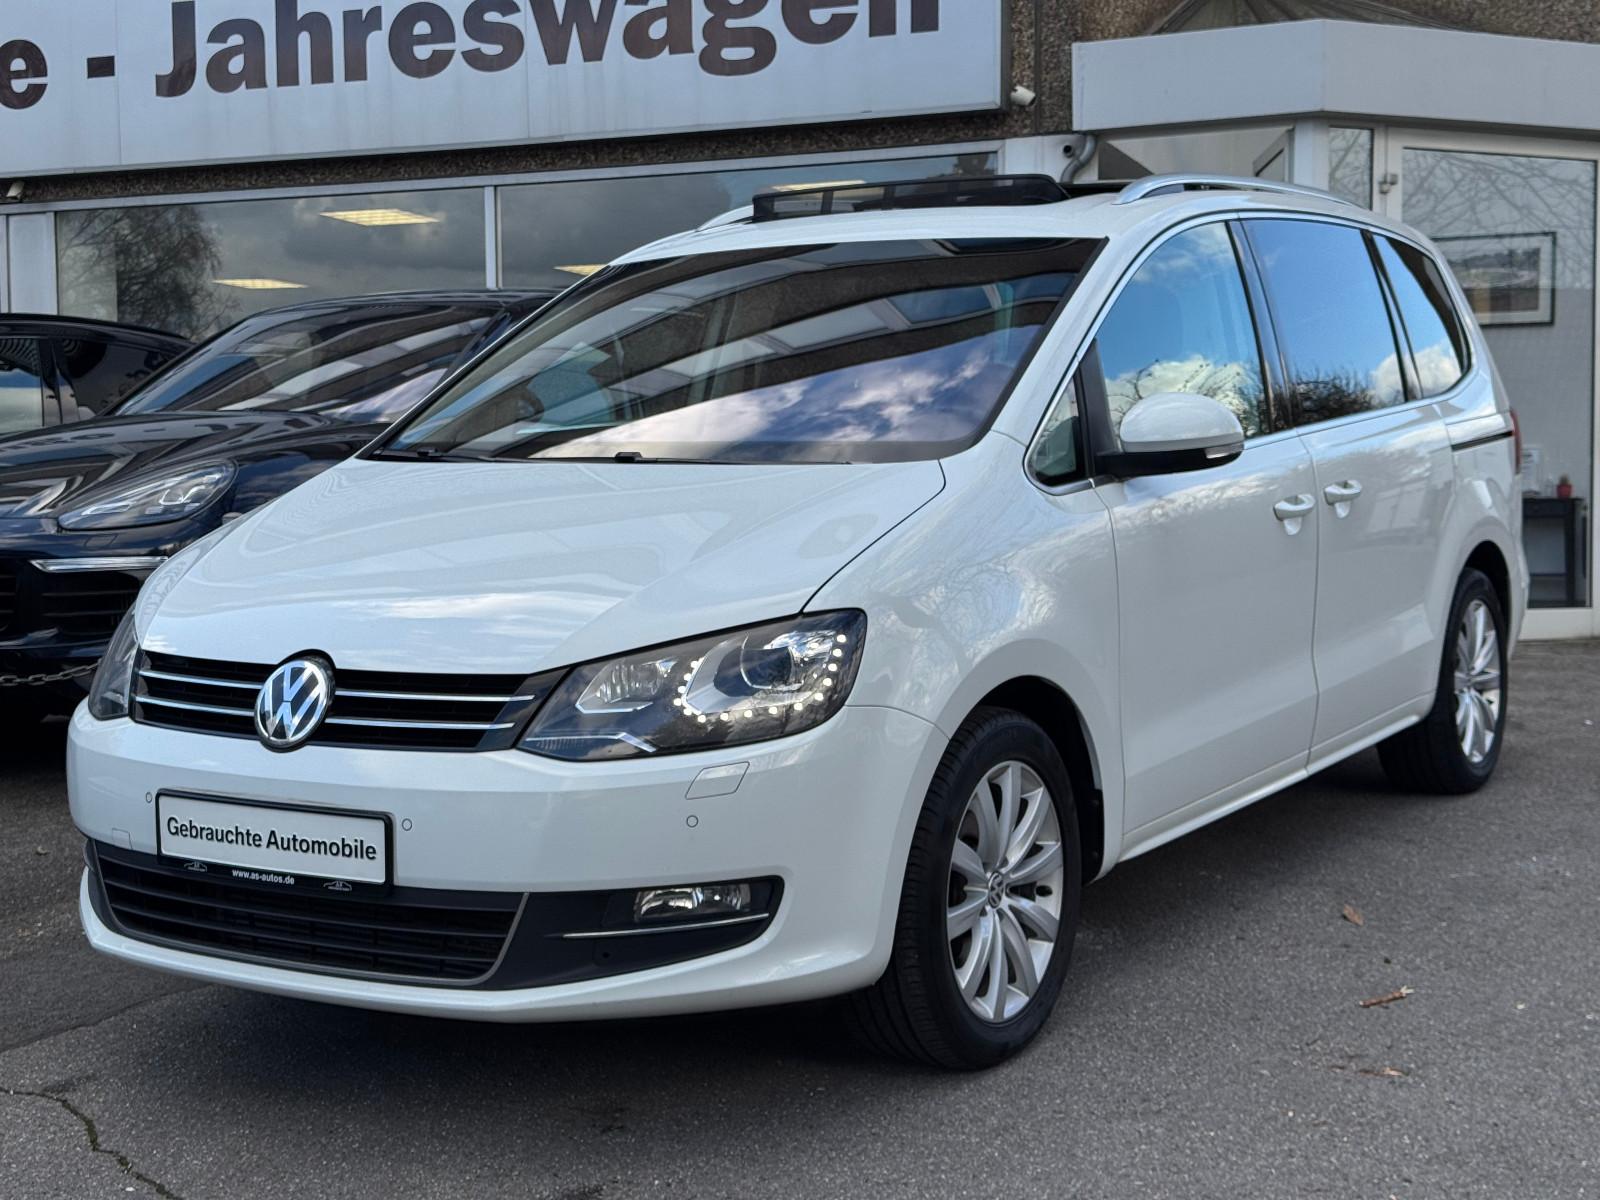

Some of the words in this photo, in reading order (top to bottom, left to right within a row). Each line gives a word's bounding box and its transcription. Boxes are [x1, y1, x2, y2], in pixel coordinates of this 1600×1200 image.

[166, 816, 263, 848] Gebrauchte
[266, 830, 377, 860] Automobile
[232, 869, 295, 885] www.as-autos.de
